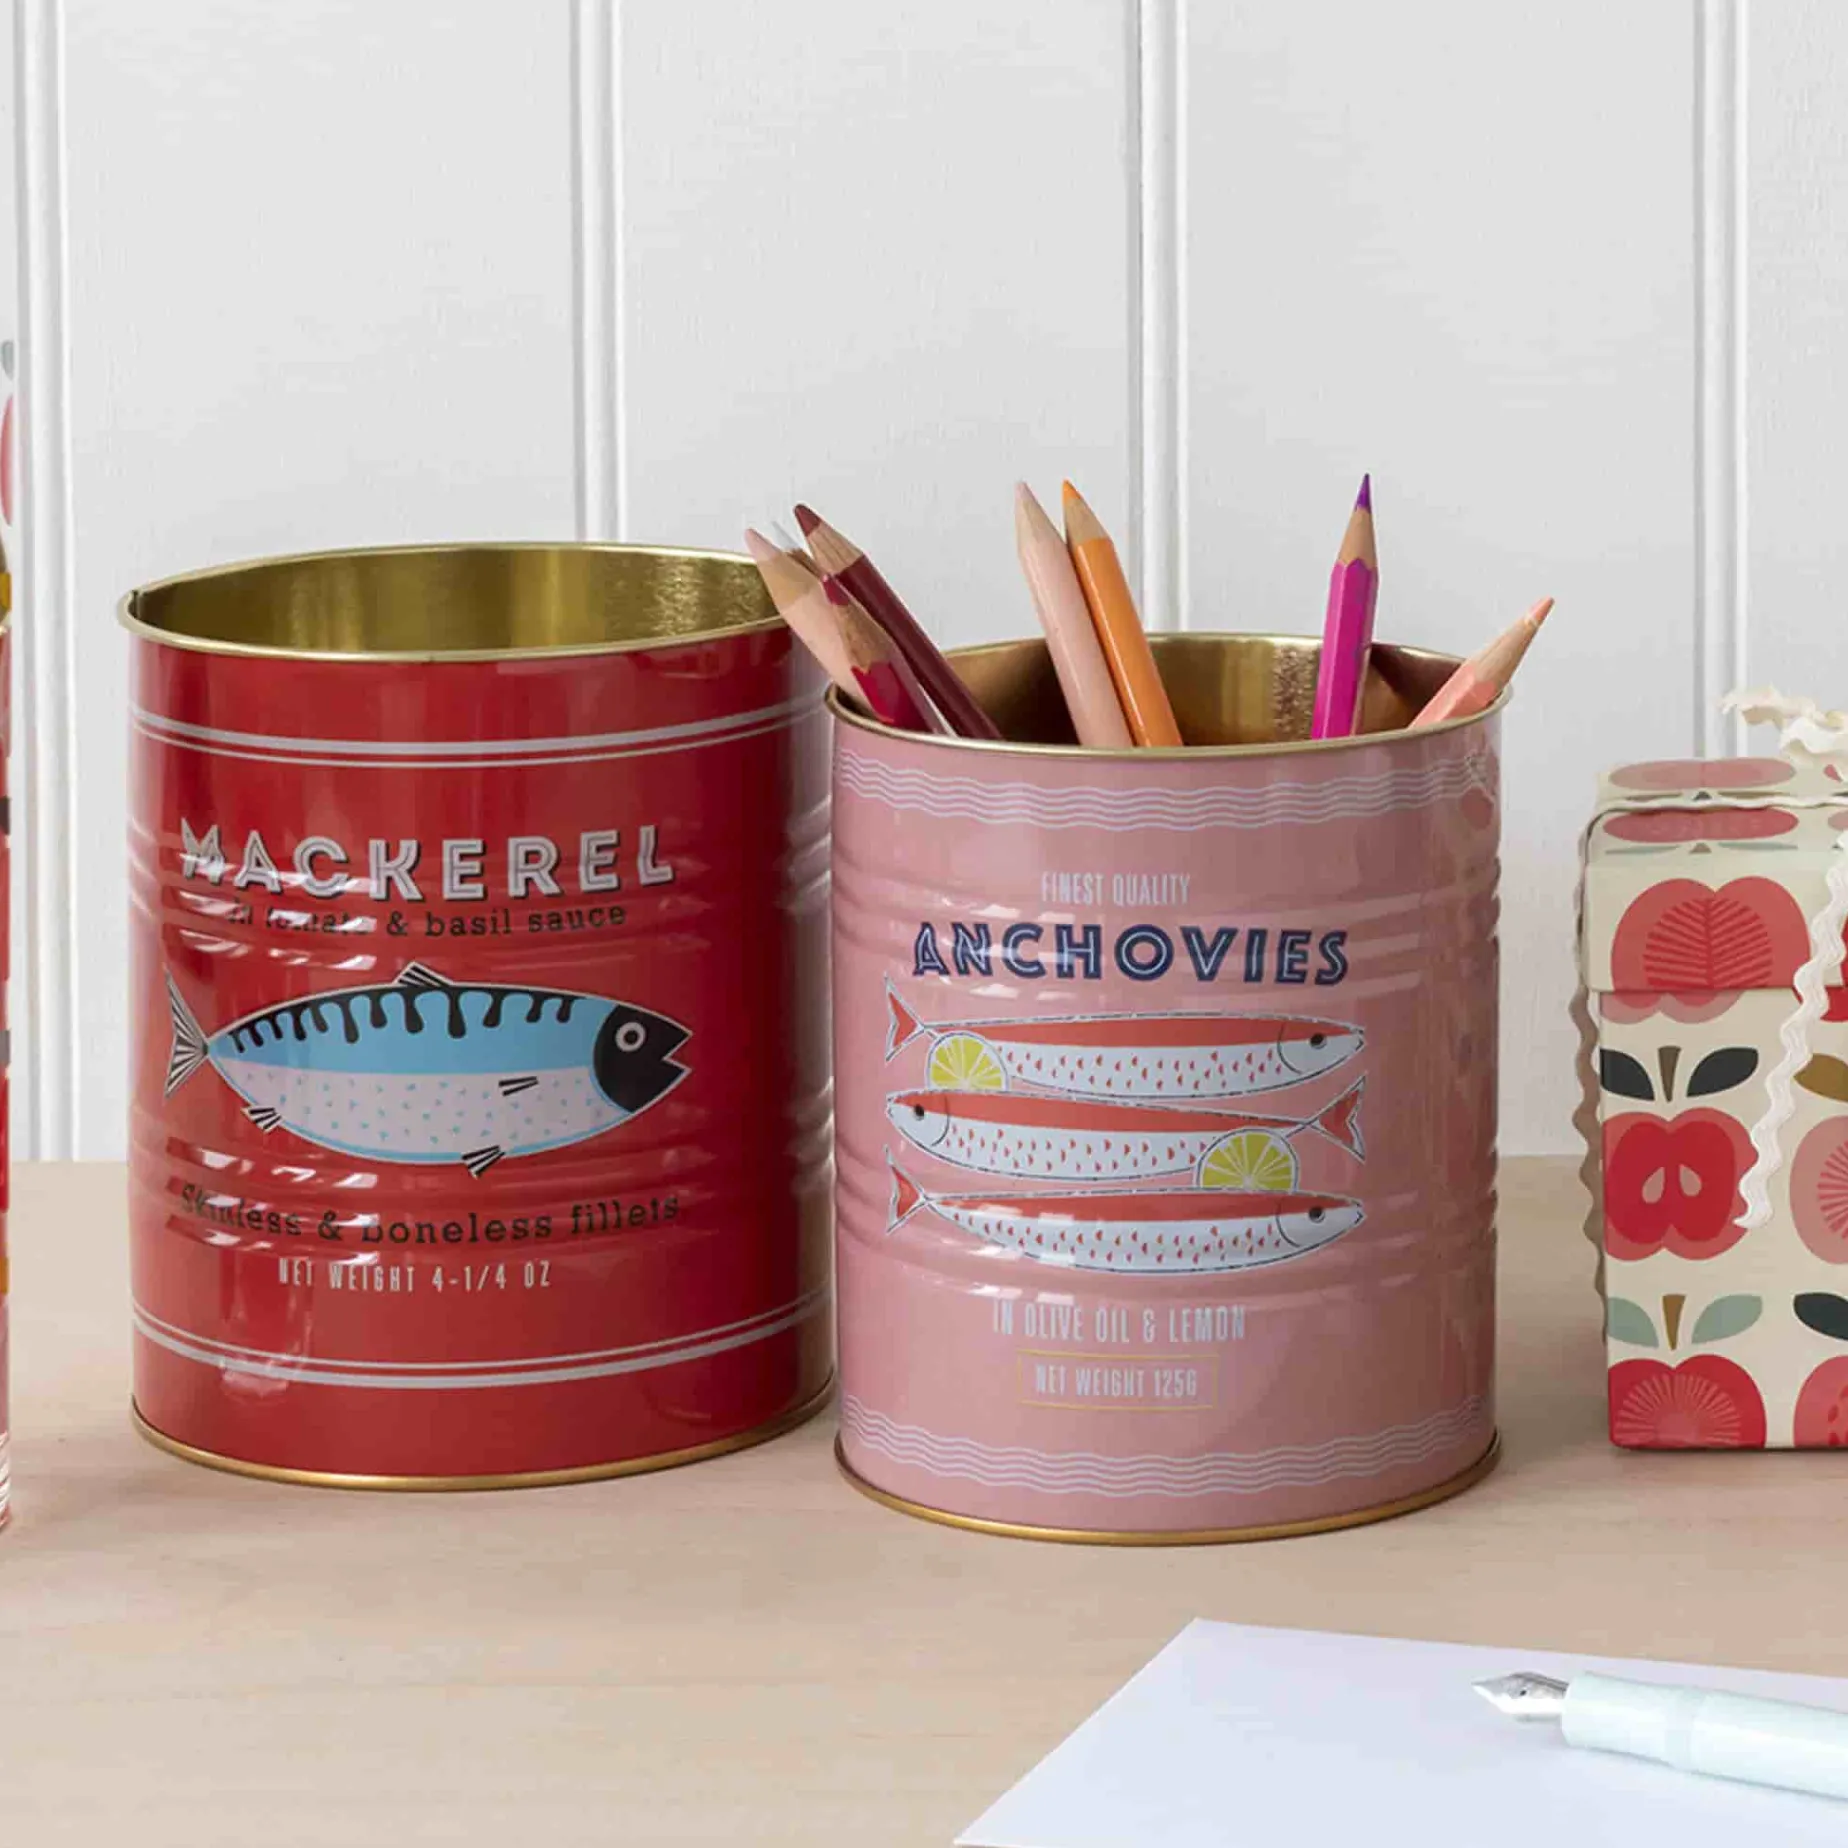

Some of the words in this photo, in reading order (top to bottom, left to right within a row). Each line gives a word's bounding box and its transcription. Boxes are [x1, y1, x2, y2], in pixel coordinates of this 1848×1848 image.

[181, 817, 674, 902] MACKEREL
[1042, 871, 1104, 905] FINEST
[1113, 872, 1191, 907] QUALITY
[265, 906, 376, 934] toat
[386, 910, 408, 936] &
[424, 908, 513, 937] basil
[528, 904, 626, 933] sauce
[912, 921, 1349, 987] ANCHOVIES
[317, 1209, 344, 1241] &
[362, 1212, 553, 1244] boneless
[571, 1197, 680, 1235] fillets
[278, 1256, 313, 1287] NET
[329, 1261, 414, 1292] WEIGHT
[432, 1263, 507, 1293] 4-1/4
[524, 1260, 551, 1288] OZ
[993, 1299, 1014, 1335] IN
[1025, 1302, 1085, 1342] OLIVE
[1096, 1306, 1131, 1343] OIL
[1143, 1308, 1156, 1343] &
[1169, 1304, 1246, 1343] LEMON
[1036, 1363, 1067, 1395] NET
[1076, 1366, 1145, 1398] WEIGHT
[1154, 1367, 1199, 1398] 125G
